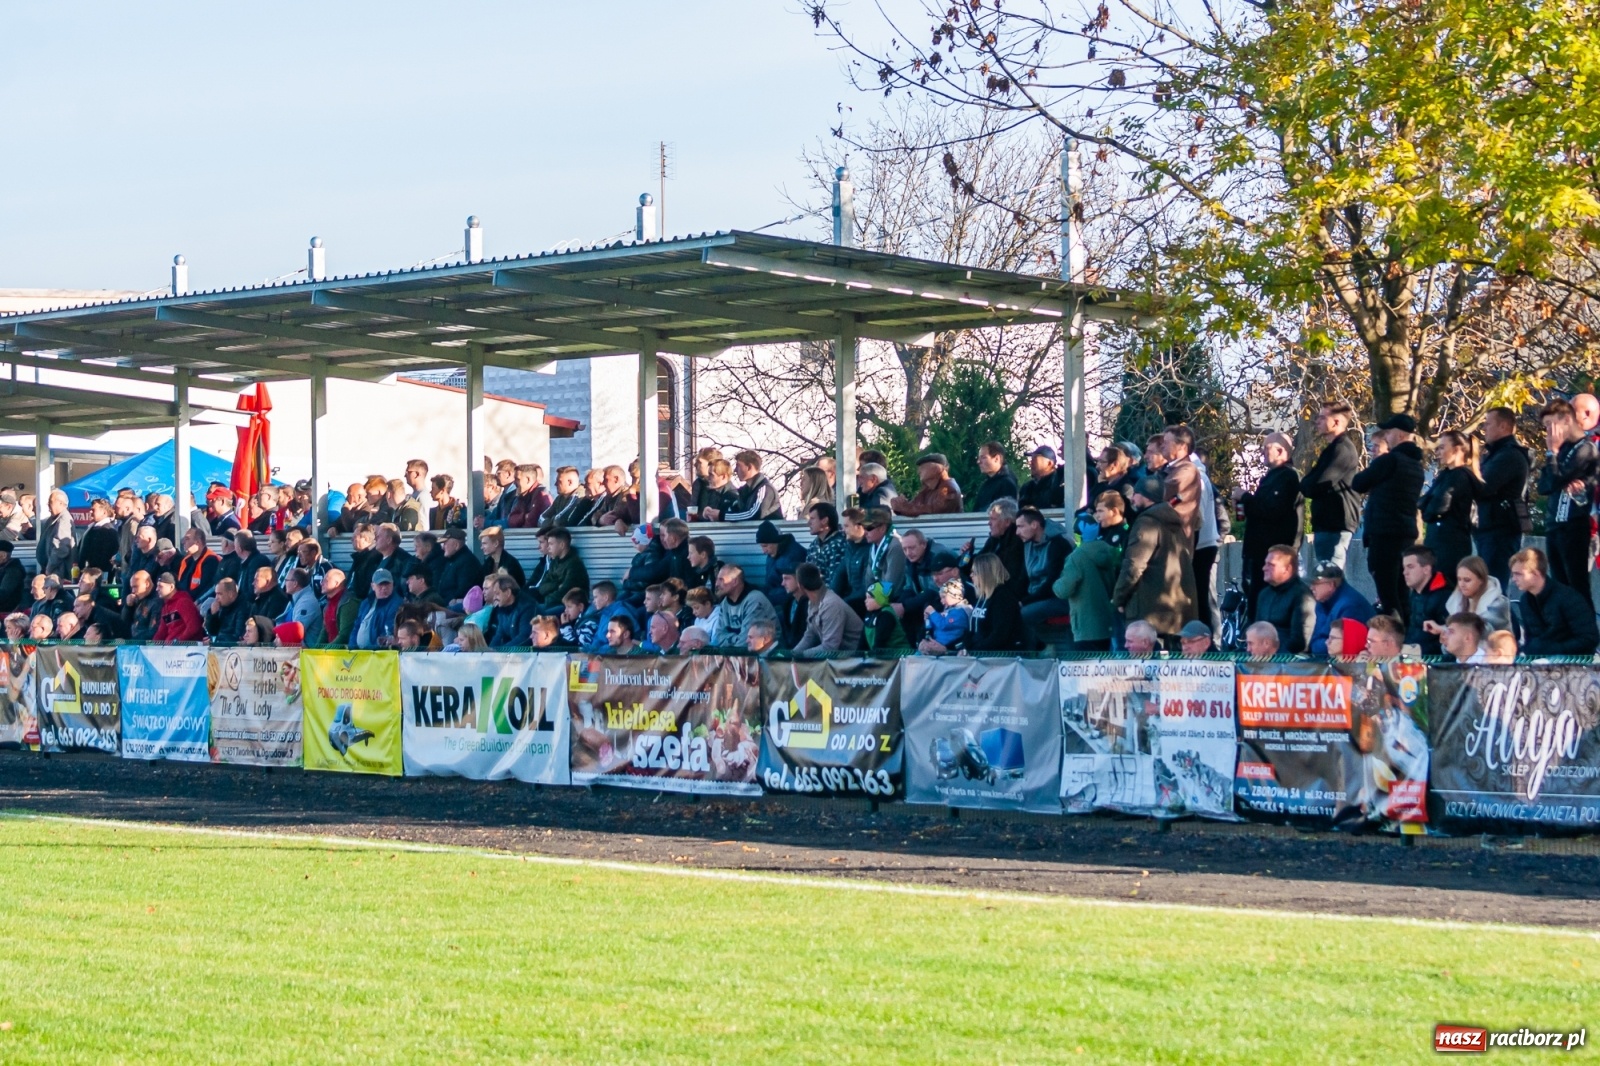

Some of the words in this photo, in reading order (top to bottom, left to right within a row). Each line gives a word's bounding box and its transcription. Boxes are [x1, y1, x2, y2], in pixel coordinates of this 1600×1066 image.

[165, 660, 200, 670] MARTCOM
[253, 657, 278, 674] Kebab
[1060, 665, 1089, 678] OSIEDLE
[1134, 663, 1177, 677] TWORKÓW
[1180, 665, 1232, 678] HANOWIEC
[604, 668, 642, 687] Producent
[834, 675, 892, 688] www.gregorbau.
[81, 681, 116, 695] BUDUJEMY
[126, 688, 170, 705] INTERNET
[253, 681, 277, 700] Frytki
[317, 686, 339, 699] POMOC
[340, 687, 372, 700] DROGOWA
[372, 688, 383, 701] 24h
[1240, 681, 1347, 710] KREWETKA
[83, 702, 92, 715] OD
[93, 702, 99, 715] A
[100, 703, 110, 716] DO
[111, 703, 117, 716] Z
[220, 694, 232, 717] The
[253, 700, 272, 721] Lody
[411, 676, 555, 735] KERAKOIL
[1163, 698, 1184, 717] 600
[1209, 700, 1232, 719] 516
[604, 701, 678, 732] kiełbasa
[833, 707, 891, 724] BUDUJEMY
[1242, 711, 1263, 722] SKLEP
[1264, 712, 1290, 723] RYBNY
[1303, 711, 1348, 724] SMAŻALNIA
[41, 725, 58, 746] tel.
[59, 727, 73, 746] 665
[76, 728, 96, 748] 092
[99, 730, 118, 750] 363
[443, 736, 458, 750] The
[831, 734, 847, 749] OD
[848, 734, 855, 749] A
[857, 734, 876, 751] DO
[880, 735, 891, 752] Z
[1206, 730, 1215, 739] do
[1464, 671, 1583, 801] Alicja
[632, 721, 711, 772] szefa
[763, 763, 790, 790] tel.
[794, 766, 824, 792] 665
[822, 766, 860, 792] 092
[1501, 763, 1530, 777] SKLEP
[1545, 764, 1600, 779] ODZIEŻOWY
[1533, 803, 1578, 821] ŻANETA
